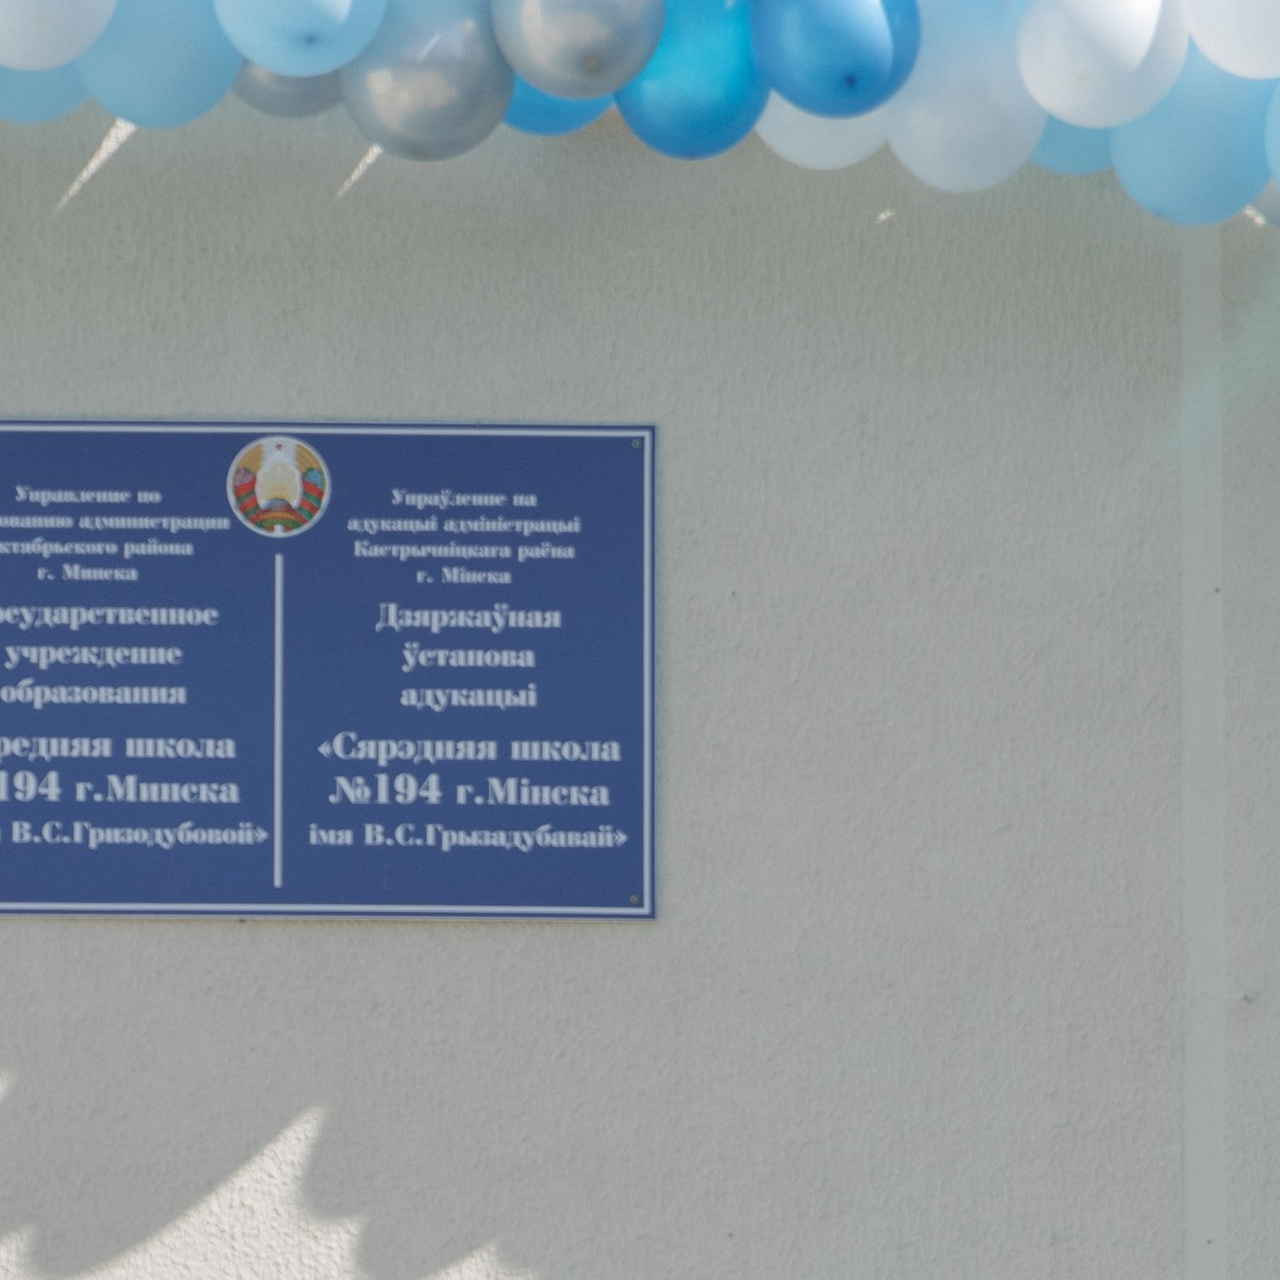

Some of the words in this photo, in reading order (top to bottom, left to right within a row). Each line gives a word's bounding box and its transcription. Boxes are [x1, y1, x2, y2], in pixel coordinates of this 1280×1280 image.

[16, 486, 130, 506] Управление
[138, 492, 161, 503] по
[513, 495, 537, 506] па
[79, 514, 231, 533] администрации
[347, 516, 437, 534] адукацыі
[444, 517, 580, 536] адміністрацыі
[124, 539, 193, 559] района
[354, 540, 511, 561] Кастрычніцкага
[518, 542, 575, 562] раёна
[38, 568, 54, 579] г.
[63, 564, 138, 580] Минска
[417, 571, 433, 582] г.
[442, 567, 511, 583] Мінска
[376, 603, 561, 633] Дзяржаўная
[5, 646, 182, 670] учреждение
[402, 642, 535, 672] ўстанова
[0, 678, 186, 709] образования
[400, 683, 537, 712] адукацыі
[126, 738, 235, 758] школа
[318, 732, 497, 767] «Сярэдняя
[511, 741, 620, 761] школа
[76, 775, 240, 803] г.Минска
[329, 773, 442, 804] №194
[457, 777, 609, 806] г.Мінска
[12, 821, 268, 849] В.С.Гризодубовой»
[310, 823, 353, 845] імя
[365, 824, 627, 852] В.С.Грызадубавай»
